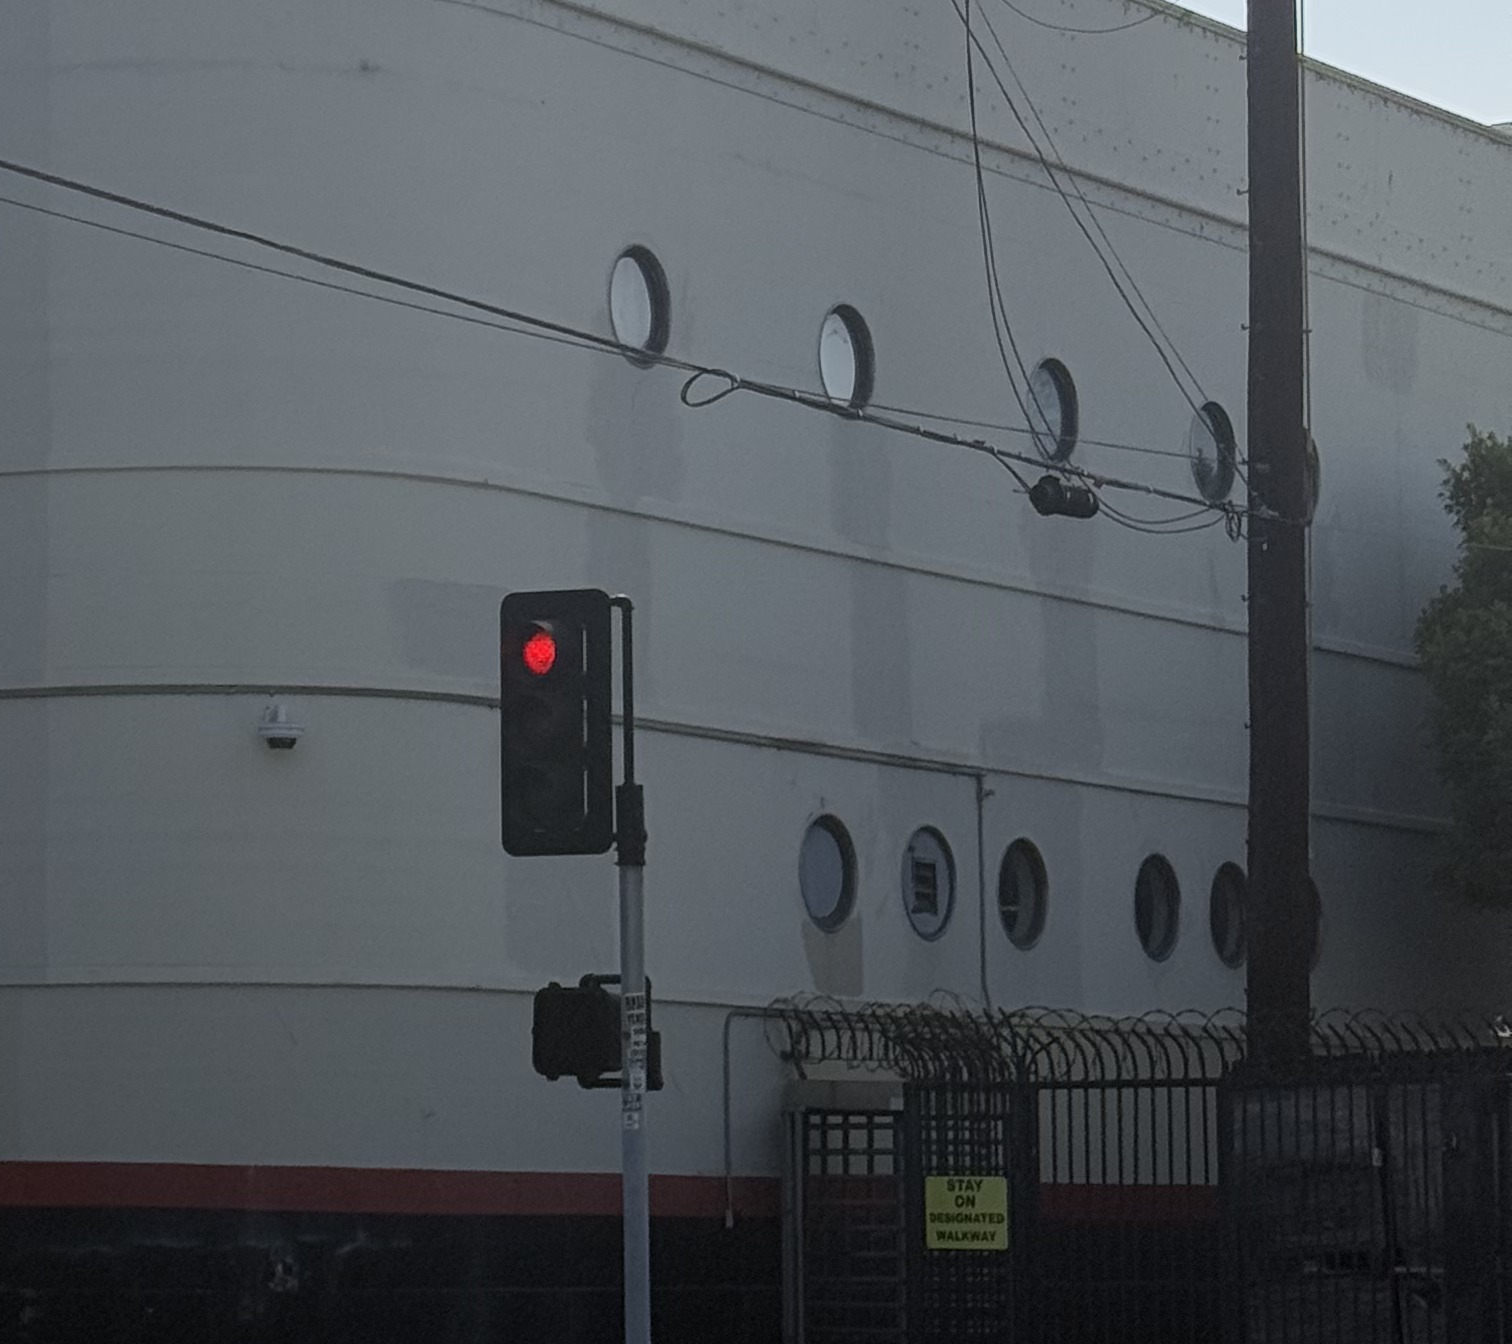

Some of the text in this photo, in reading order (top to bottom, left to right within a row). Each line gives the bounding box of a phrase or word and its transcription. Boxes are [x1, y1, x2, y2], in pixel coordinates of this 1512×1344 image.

[946, 1178, 983, 1193] STAY
[954, 1194, 976, 1208] ON
[929, 1212, 1005, 1224] DESIGNATED
[936, 1230, 996, 1242] WALKWAY
